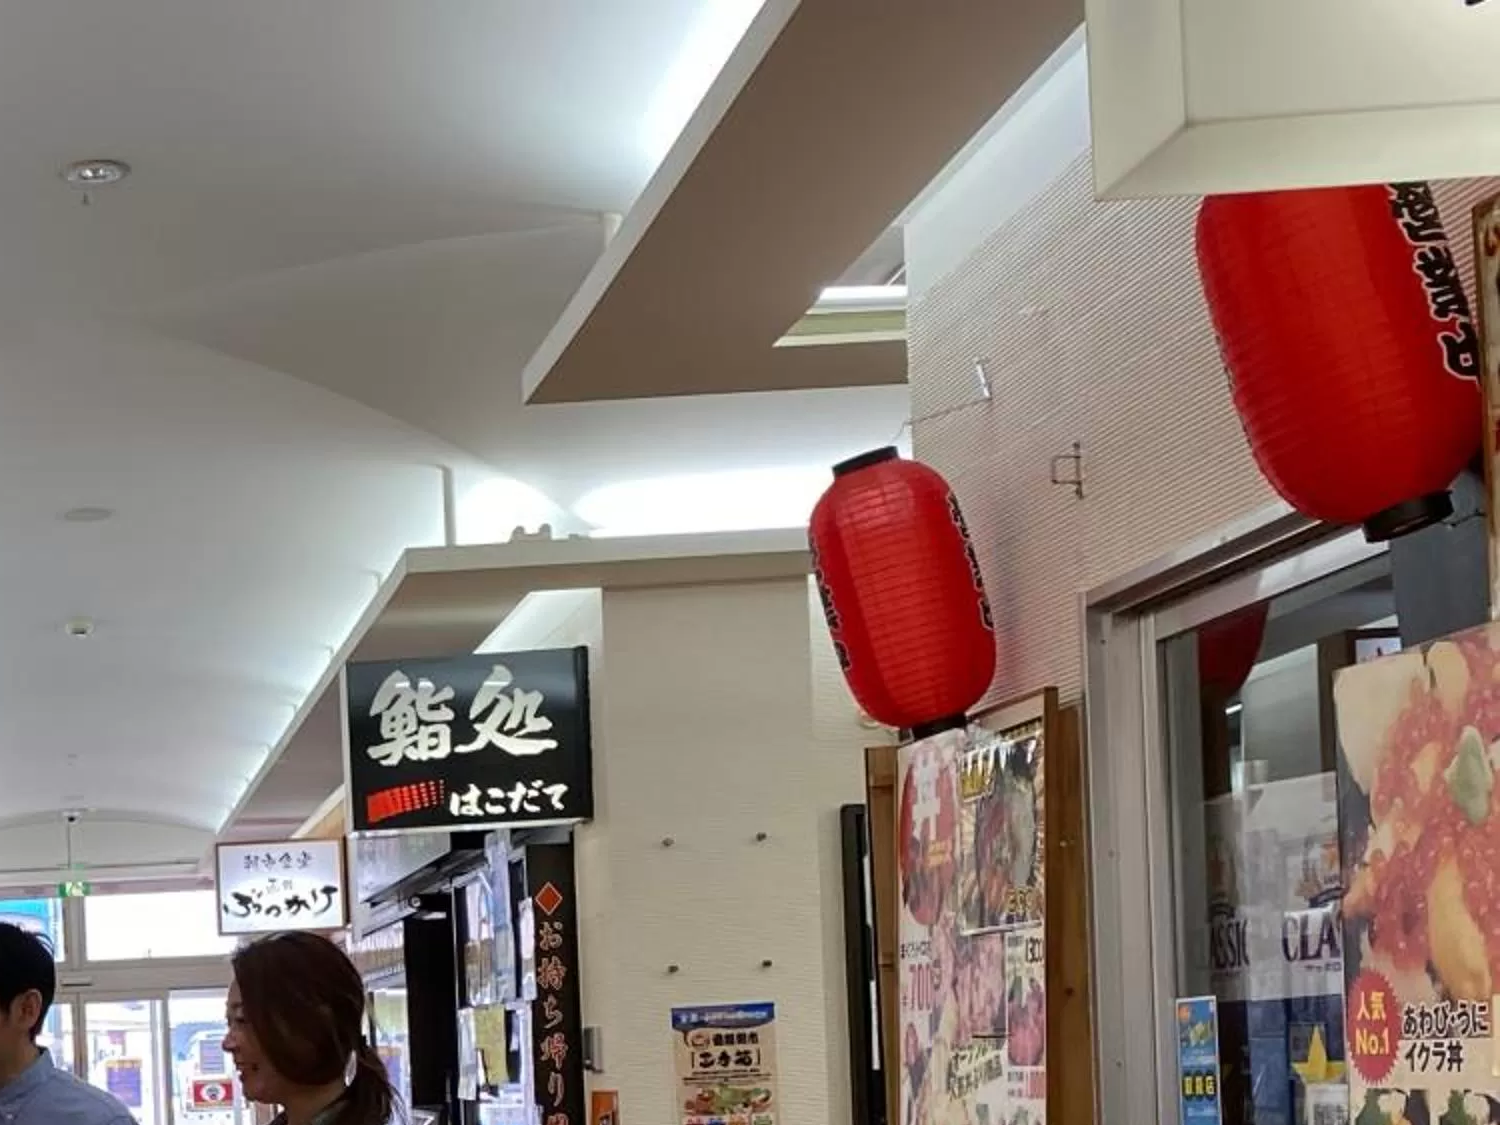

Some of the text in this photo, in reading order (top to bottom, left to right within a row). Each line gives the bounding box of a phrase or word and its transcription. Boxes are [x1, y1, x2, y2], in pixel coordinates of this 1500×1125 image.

[367, 664, 557, 767] 鮨処
[449, 779, 570, 817] はこだて
[1357, 992, 1385, 1019] 人気
[1355, 1025, 1390, 1057] No.1
[1405, 1041, 1464, 1073] イクラ丼
